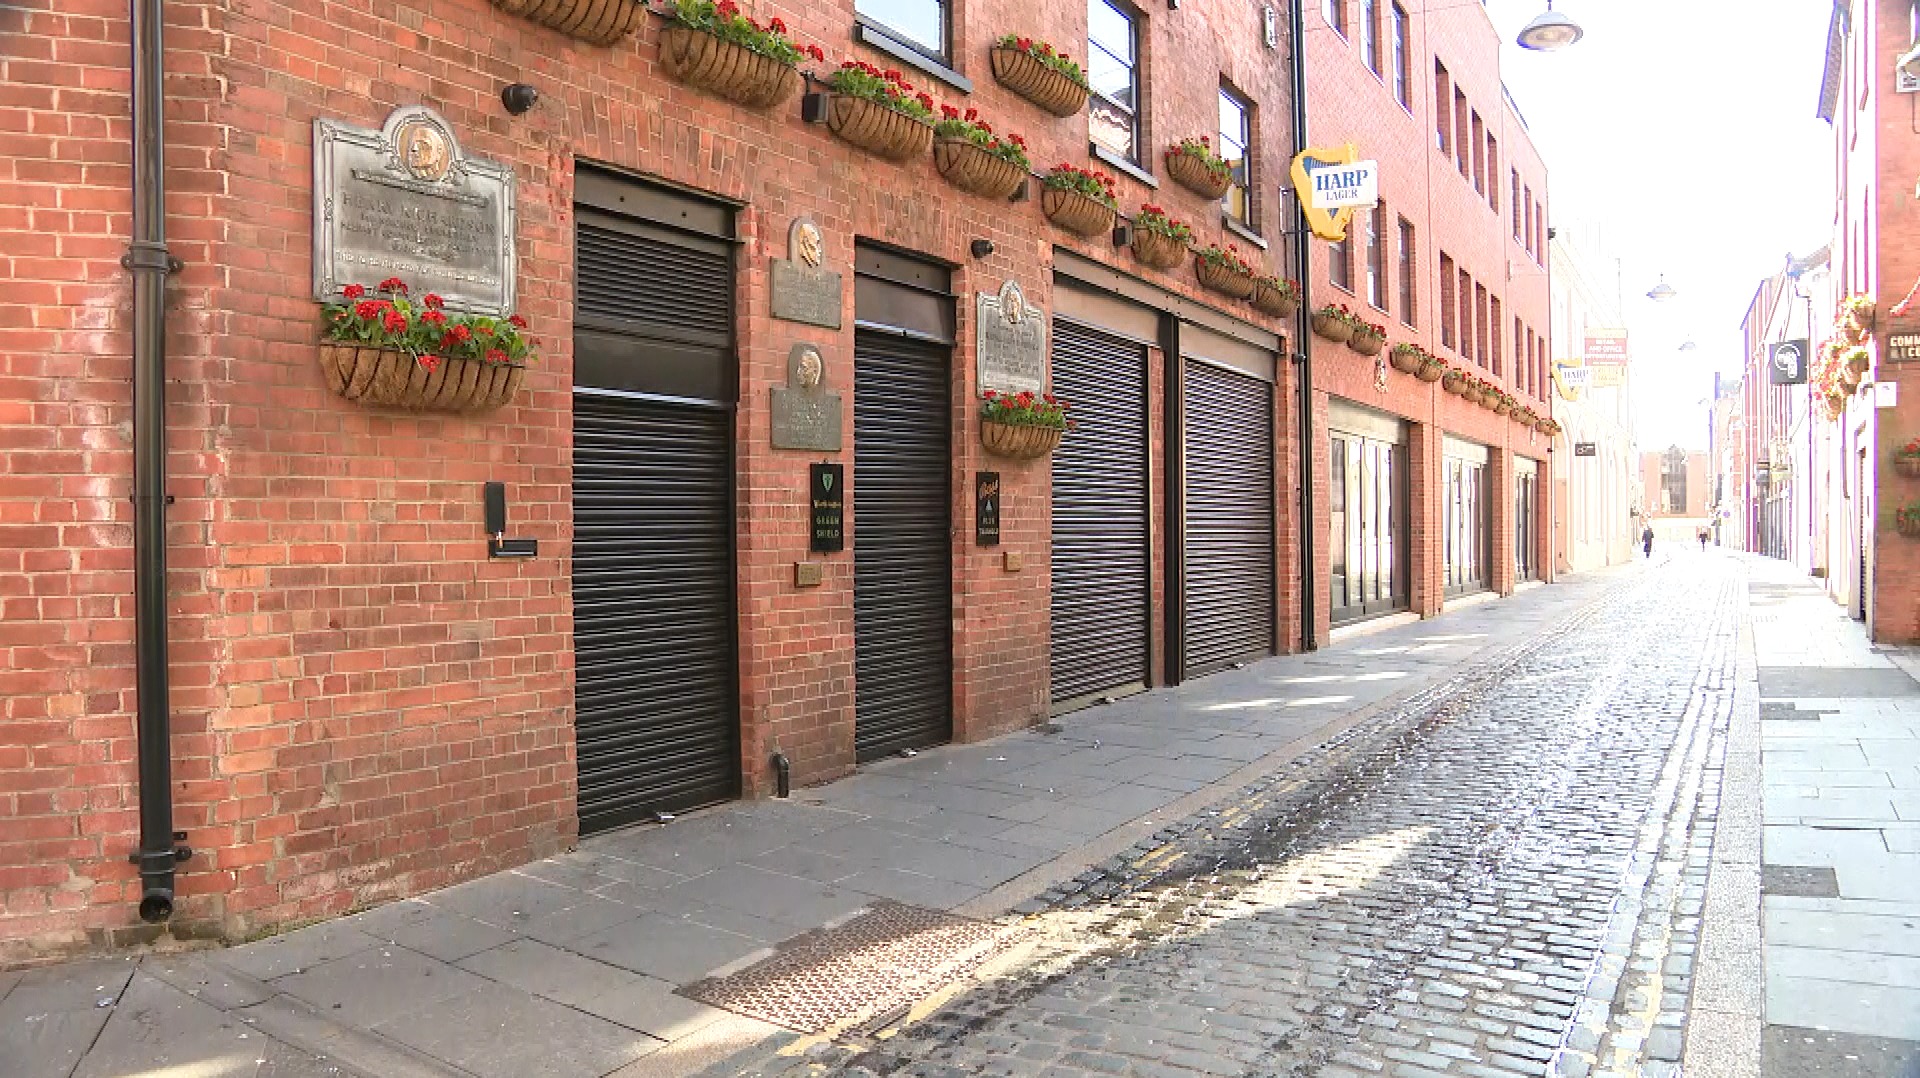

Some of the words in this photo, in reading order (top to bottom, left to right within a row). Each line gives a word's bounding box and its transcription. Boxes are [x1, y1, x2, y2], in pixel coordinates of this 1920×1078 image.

[1315, 169, 1368, 190] HARP
[1326, 189, 1358, 200] LAGER
[816, 529, 840, 539] SHIELD
